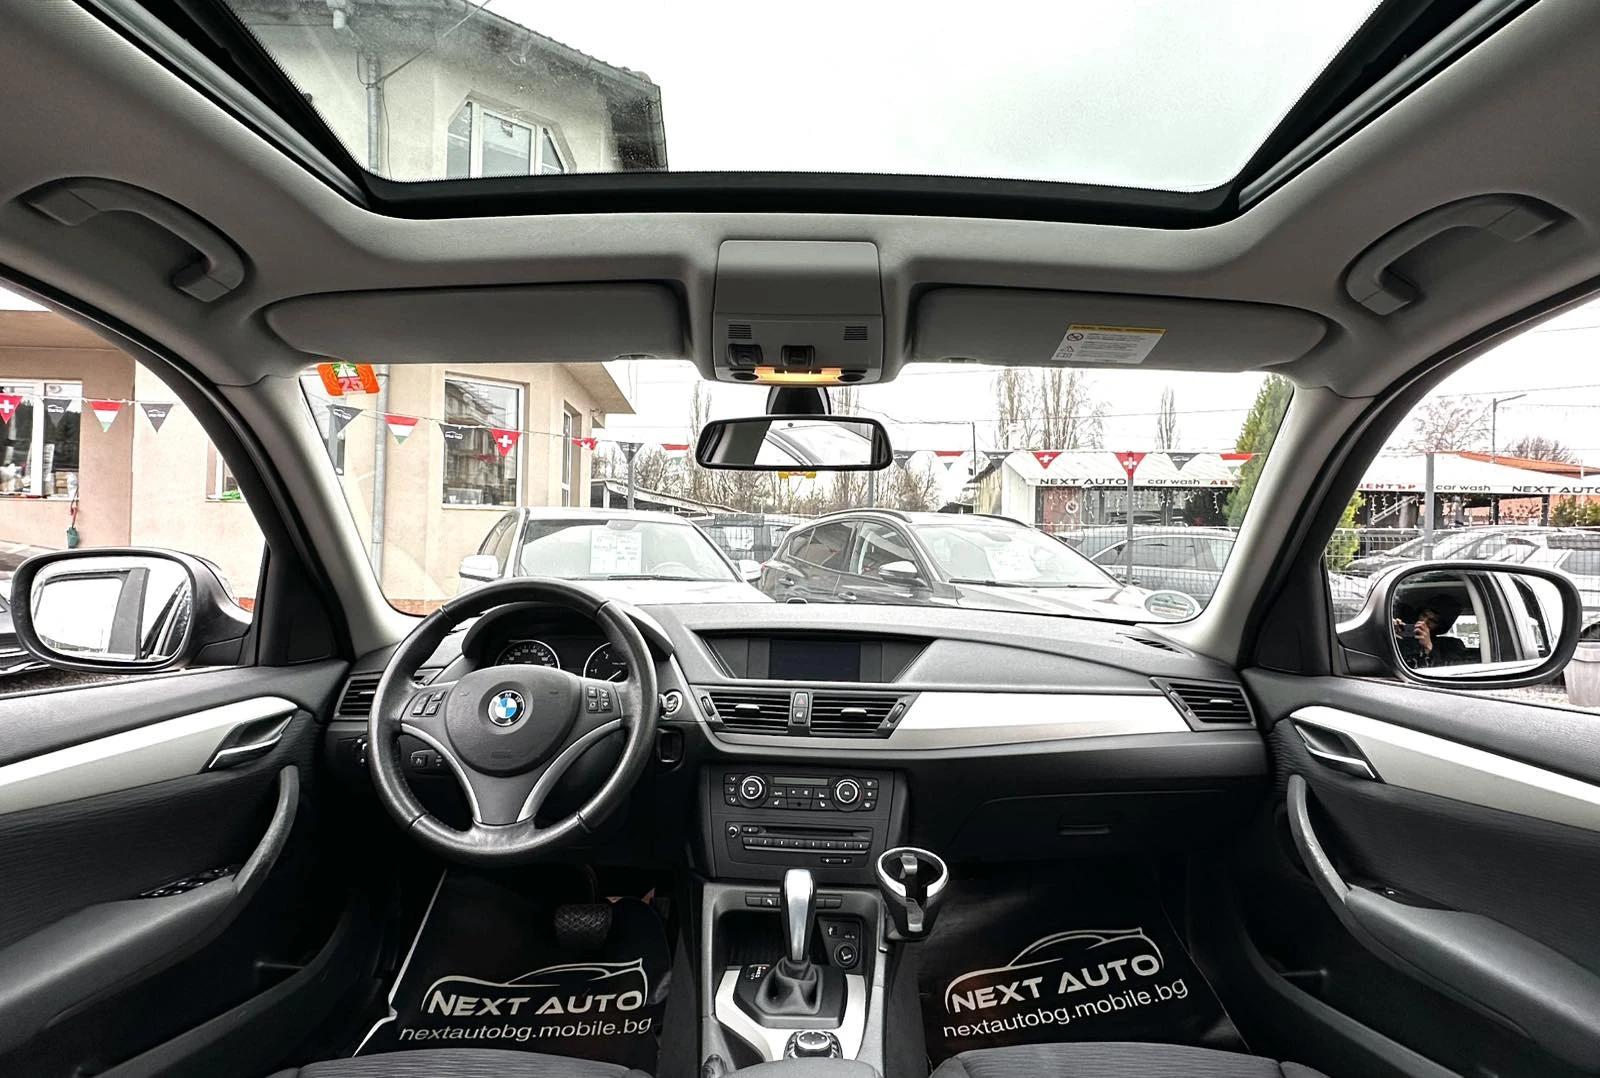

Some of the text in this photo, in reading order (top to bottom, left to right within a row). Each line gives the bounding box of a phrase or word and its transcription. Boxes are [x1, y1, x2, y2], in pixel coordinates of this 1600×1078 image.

[1512, 485, 1556, 493] NEXT
[951, 954, 1160, 1013] NEXT AUTO
[427, 990, 643, 1016] NEXT AUTO
[943, 978, 1189, 1038] nextautobg.mobile.bg
[398, 1017, 652, 1041] nextautobg.mobile.bg
